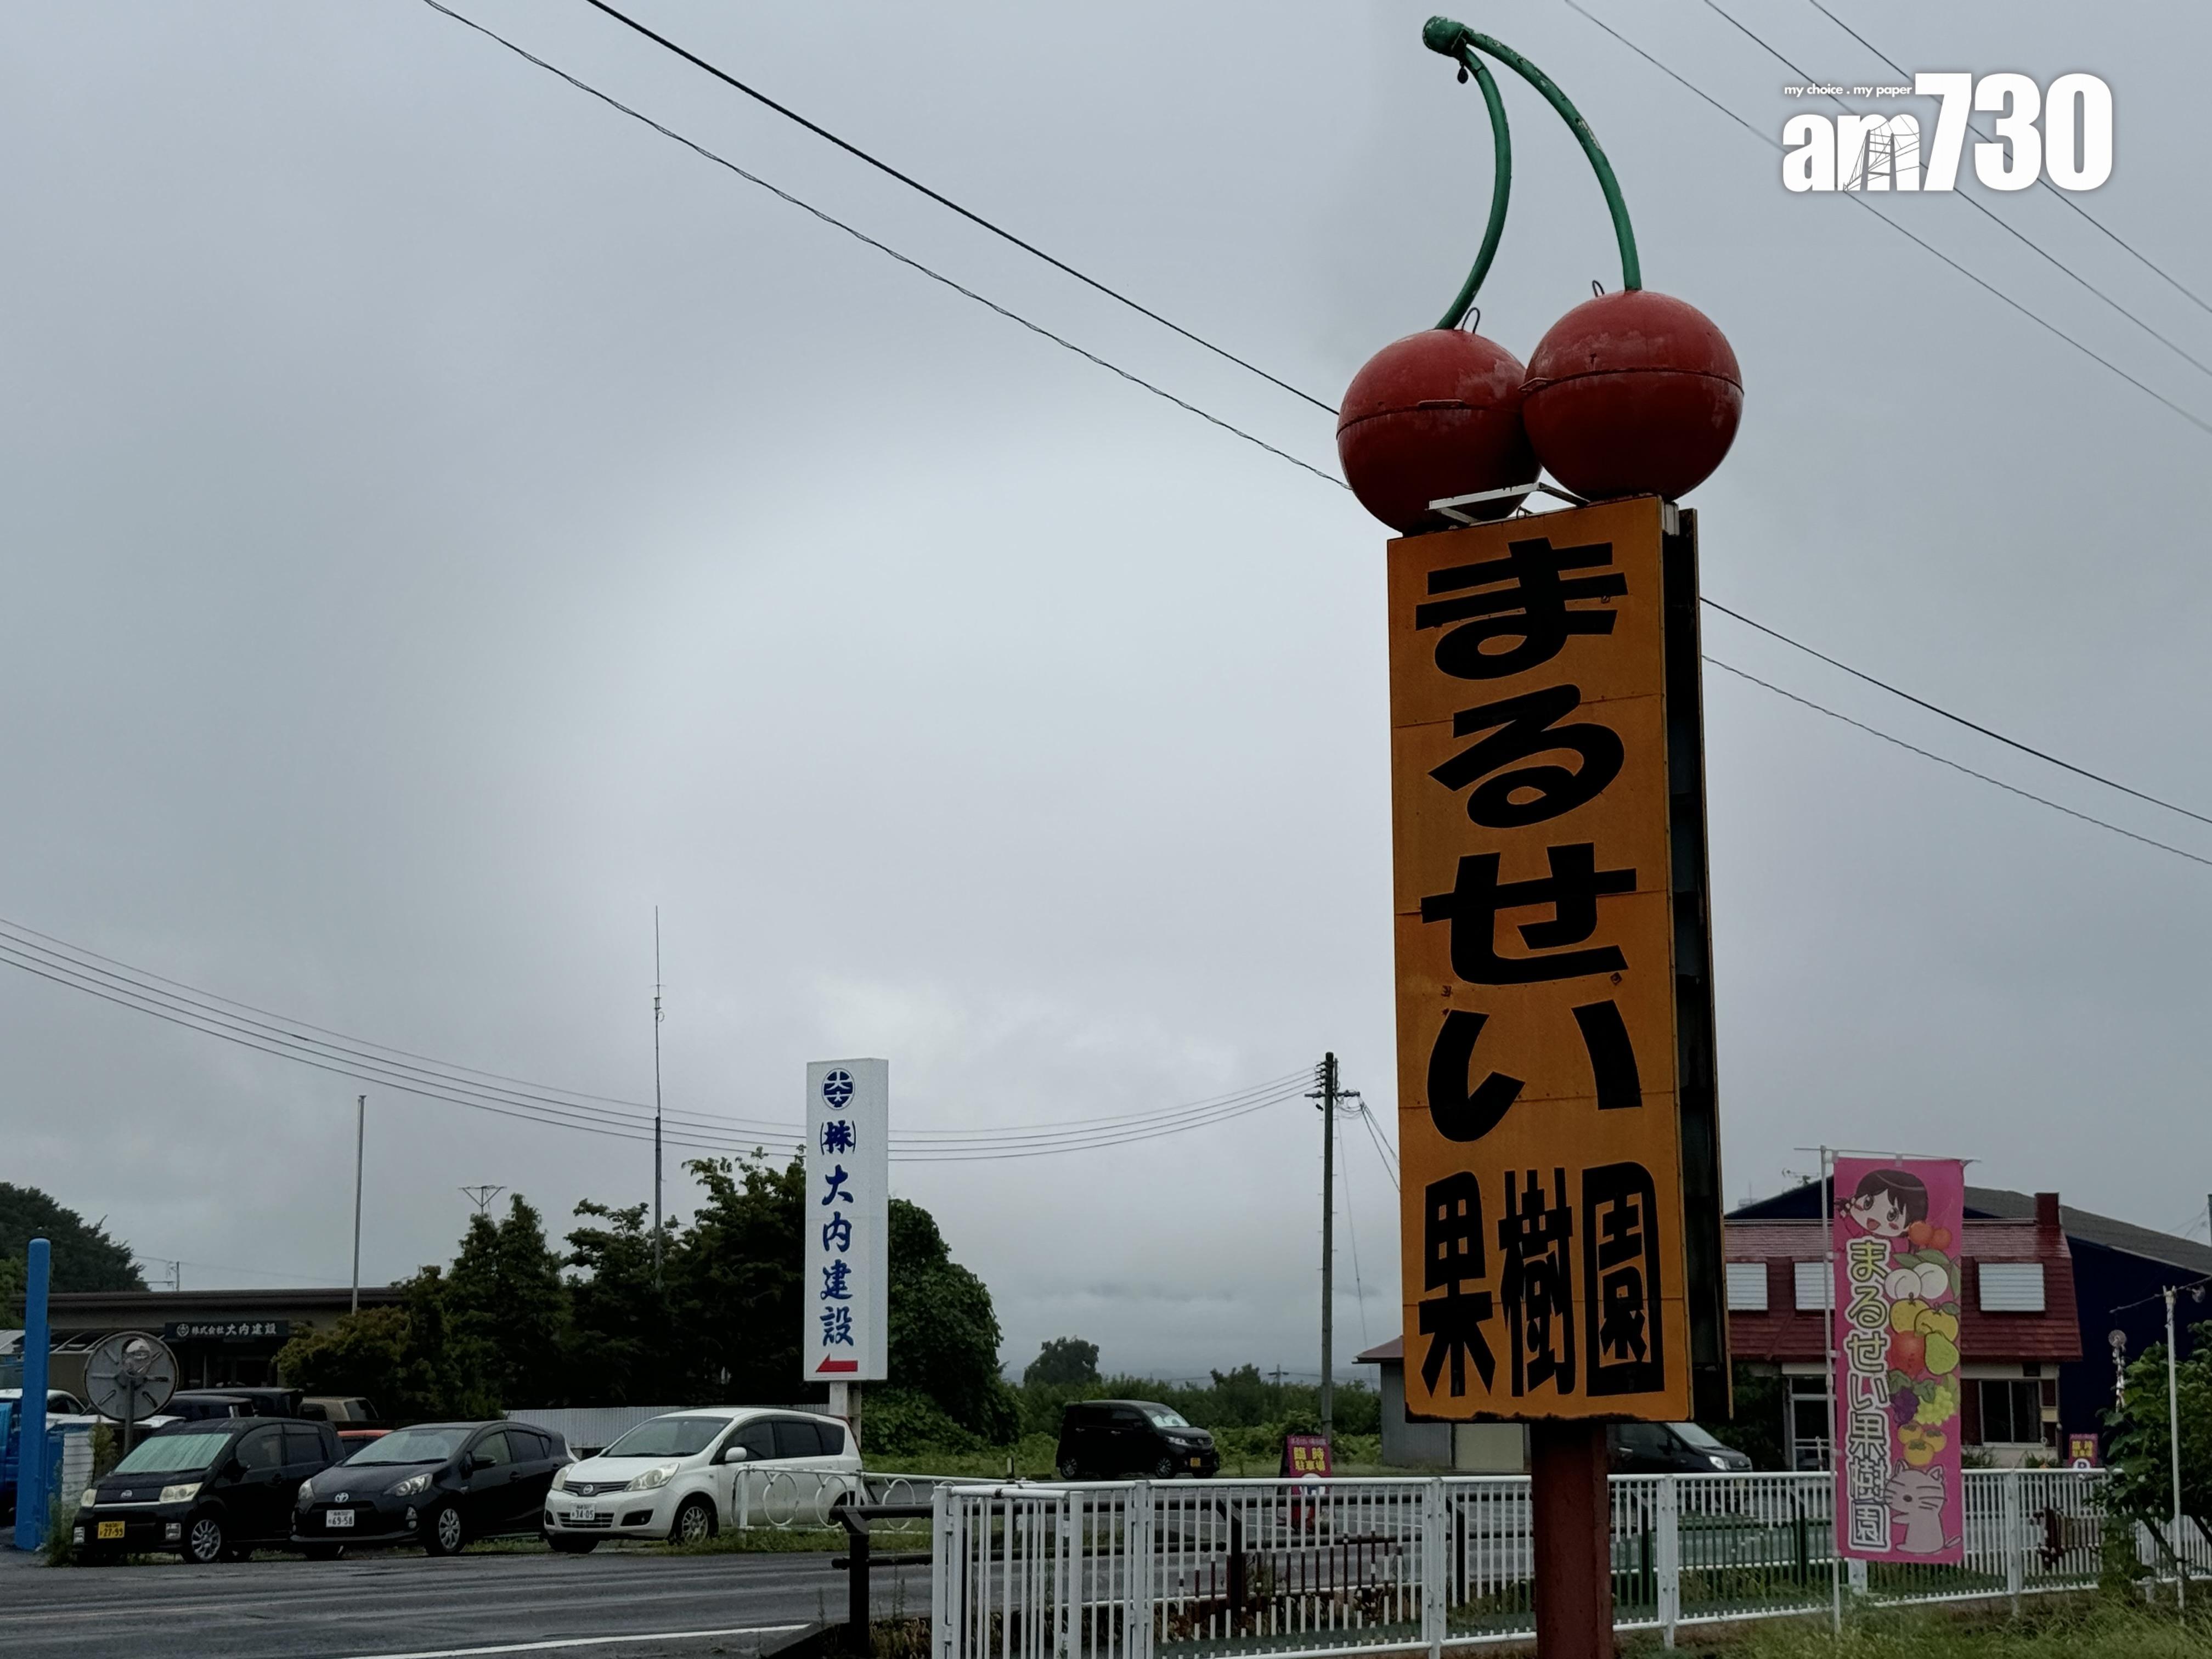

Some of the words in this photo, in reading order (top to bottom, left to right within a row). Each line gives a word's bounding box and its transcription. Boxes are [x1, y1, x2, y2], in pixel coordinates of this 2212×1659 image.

[1415, 537, 1642, 1143] まるせい
[1418, 1161, 1666, 1398] 果樹園
[1846, 1238, 1891, 1551] まるせい果樹園
